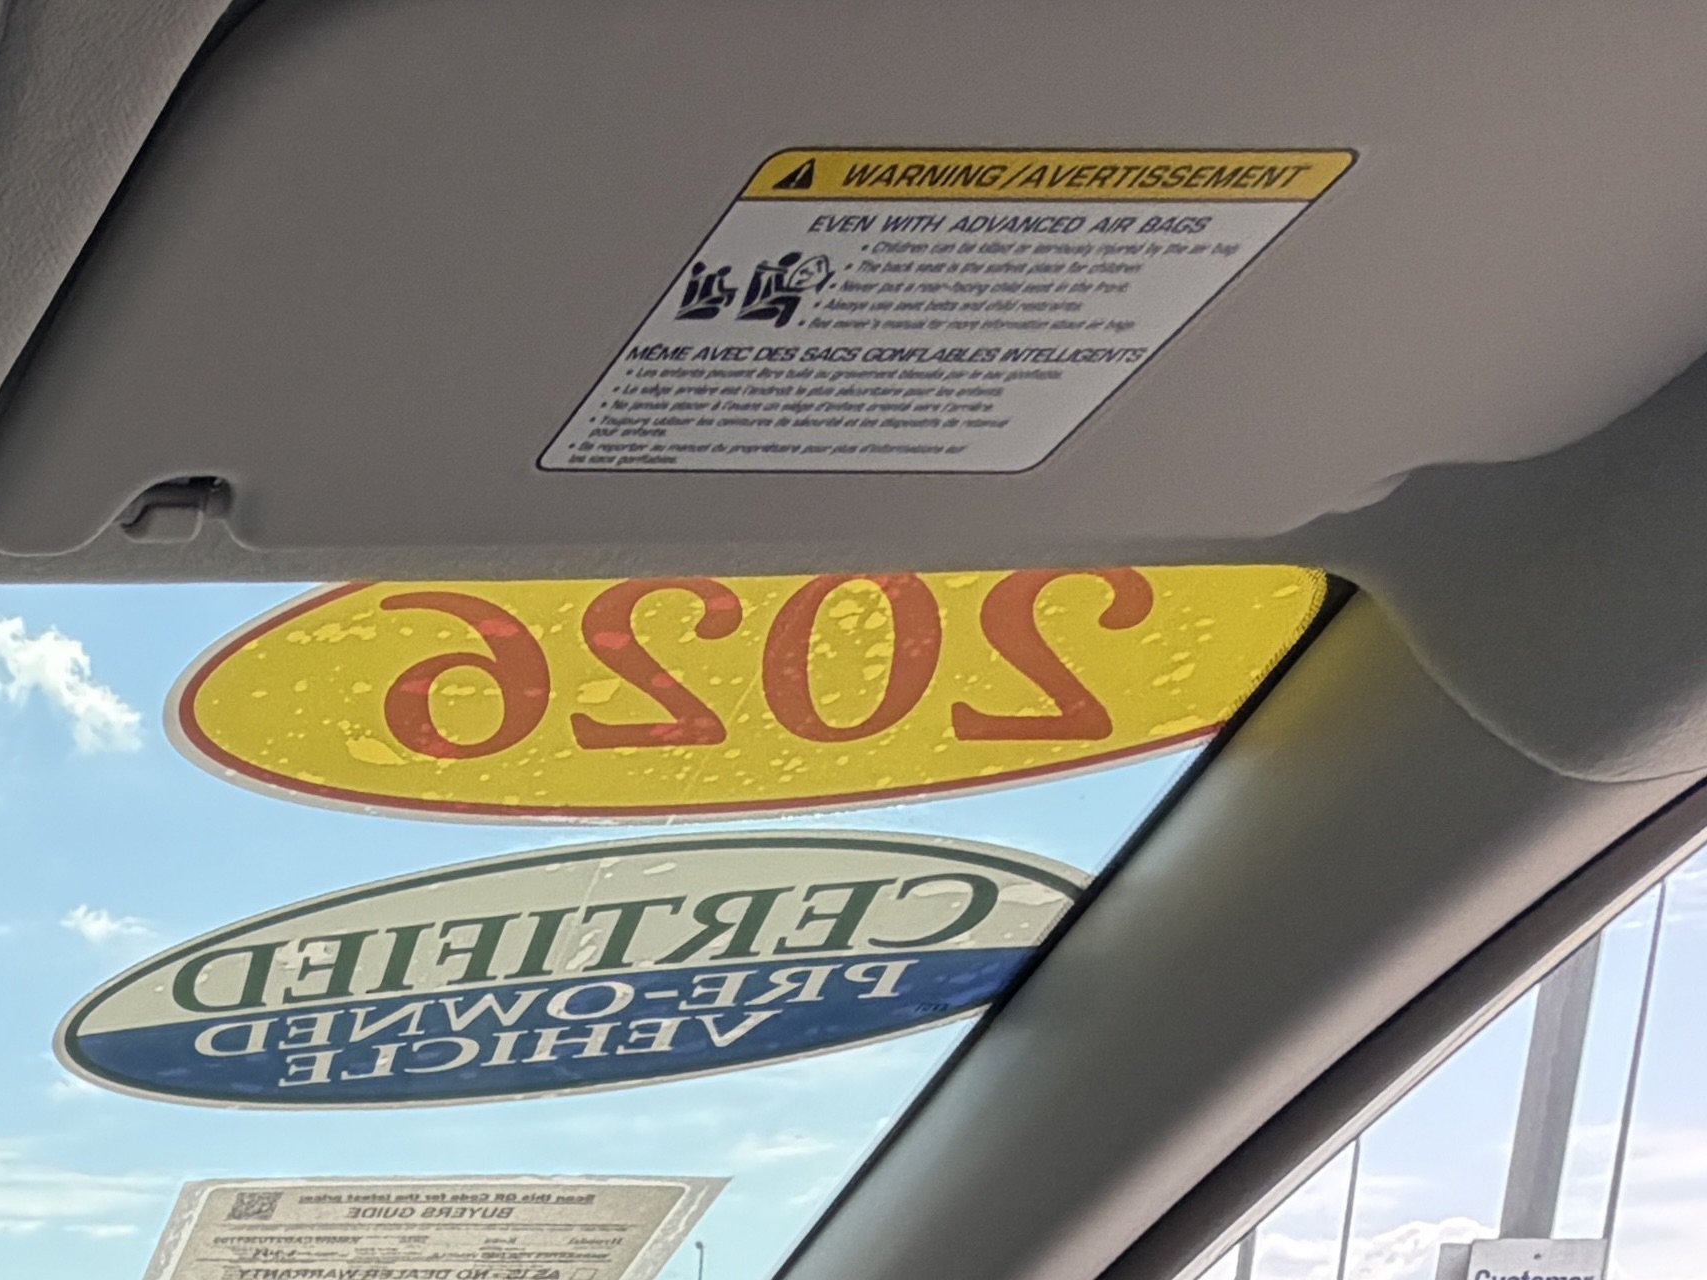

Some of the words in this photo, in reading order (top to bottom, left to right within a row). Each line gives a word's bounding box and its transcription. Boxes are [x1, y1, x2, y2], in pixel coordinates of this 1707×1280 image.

[807, 214, 873, 234] EVEN
[881, 214, 944, 234] WITH
[949, 214, 1083, 234] ADVANCED
[1089, 214, 1132, 234] AIR
[1138, 214, 1213, 234] BAGS
[626, 343, 692, 362] MÊME
[692, 346, 751, 362] AVEC
[753, 346, 799, 362] DES
[800, 346, 862, 362] SACS
[1001, 347, 1150, 365] INTELLIGENTS
